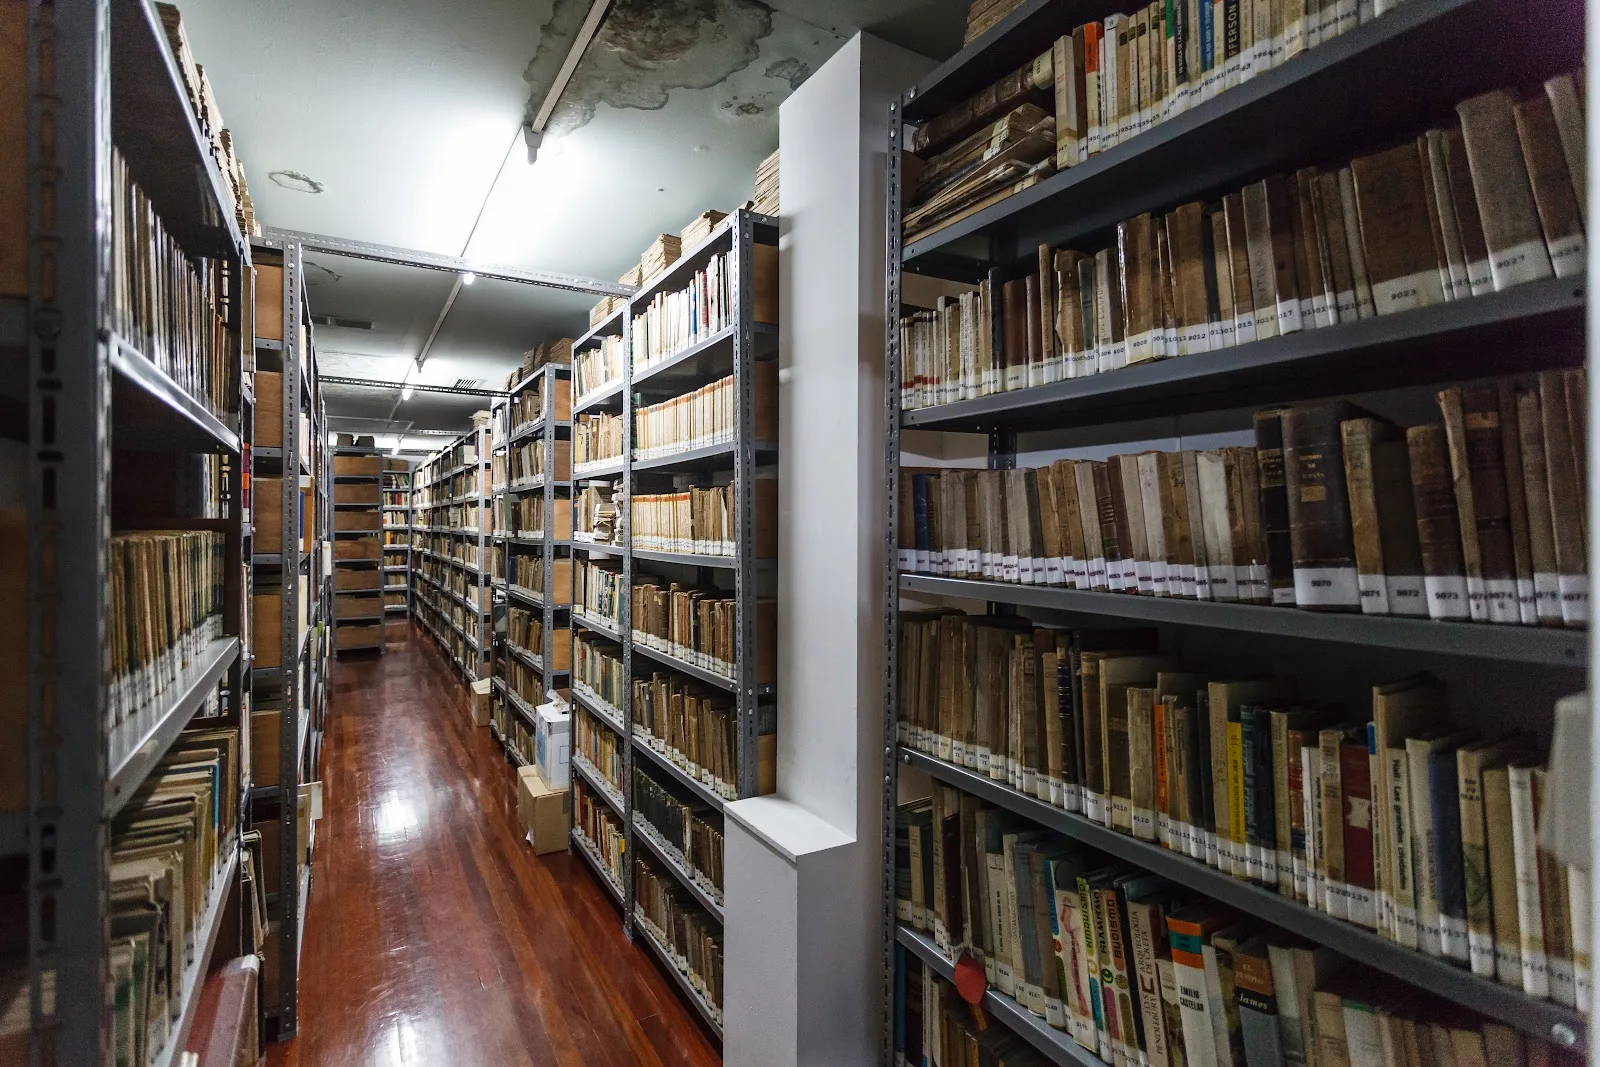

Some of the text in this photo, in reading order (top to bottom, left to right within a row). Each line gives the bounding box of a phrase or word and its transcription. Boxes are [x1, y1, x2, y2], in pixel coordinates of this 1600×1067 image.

[1079, 883, 1092, 948] HINDUISMO
[1094, 892, 1107, 954] ISLAMISMO
[1107, 899, 1122, 959] BUDISMO
[1141, 931, 1153, 975] DE CRETA
